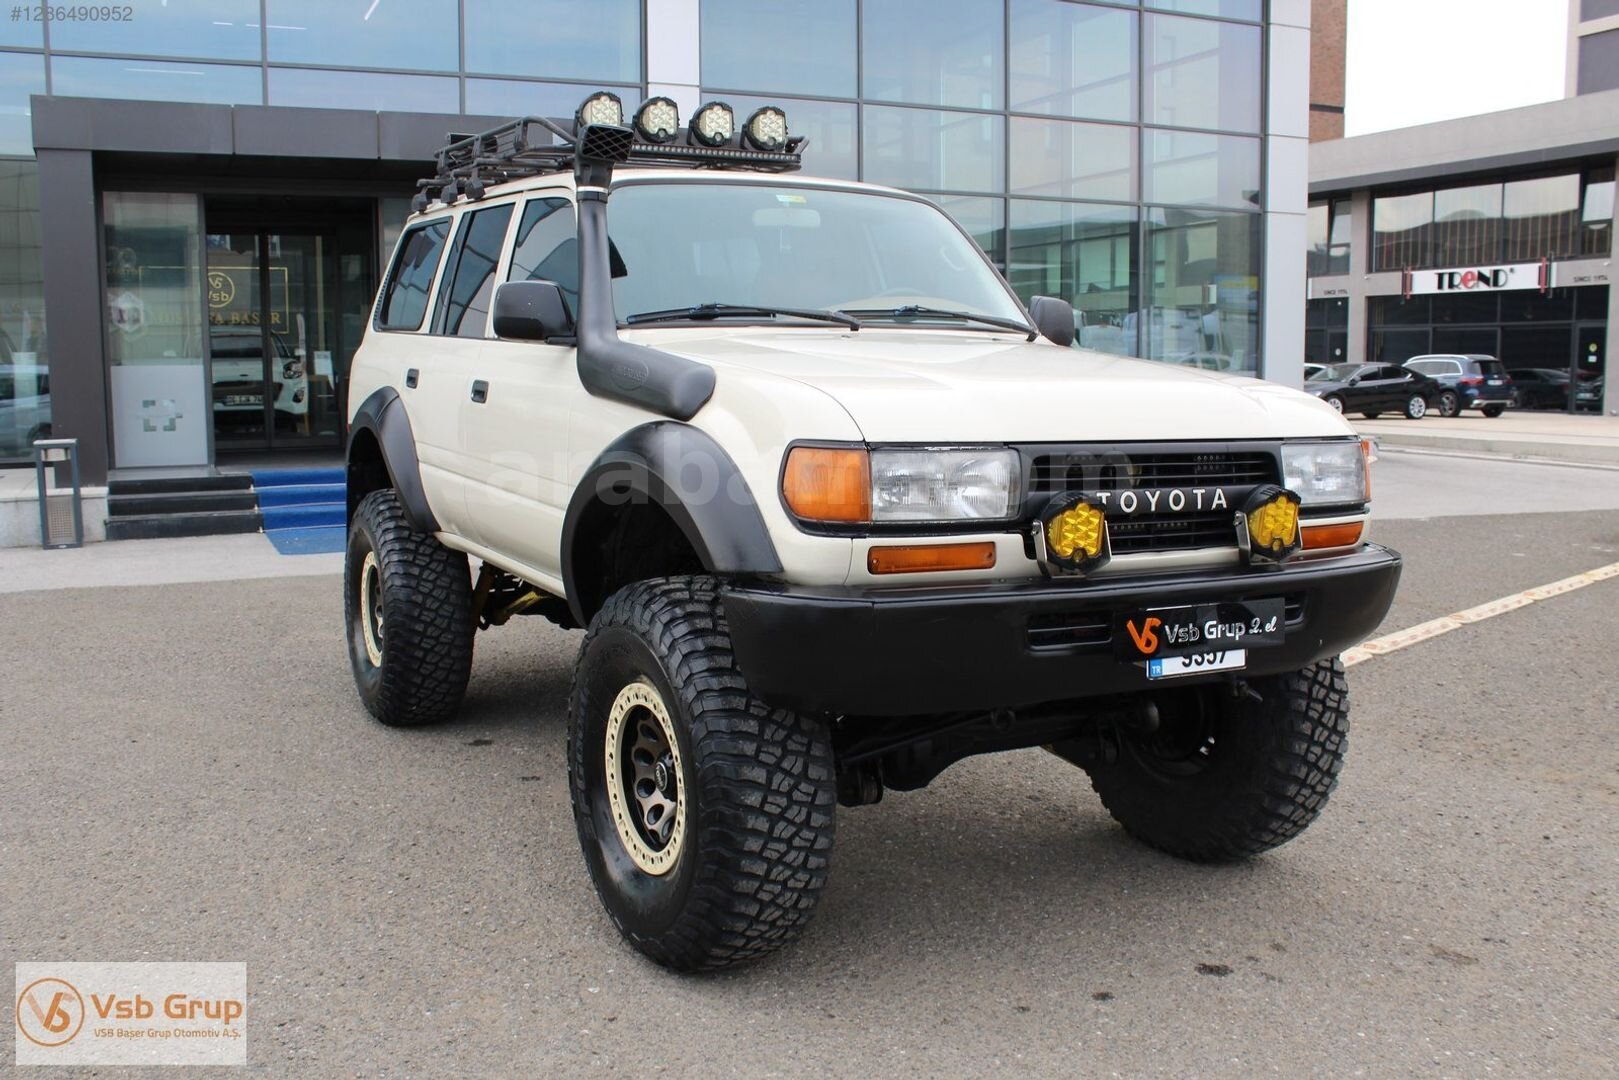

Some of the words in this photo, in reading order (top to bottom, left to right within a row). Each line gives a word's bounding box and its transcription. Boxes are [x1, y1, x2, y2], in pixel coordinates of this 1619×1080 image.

[1096, 488, 1228, 513] TOYOTA
[1164, 623, 1200, 644] Vsb
[1204, 620, 1246, 641] Grup
